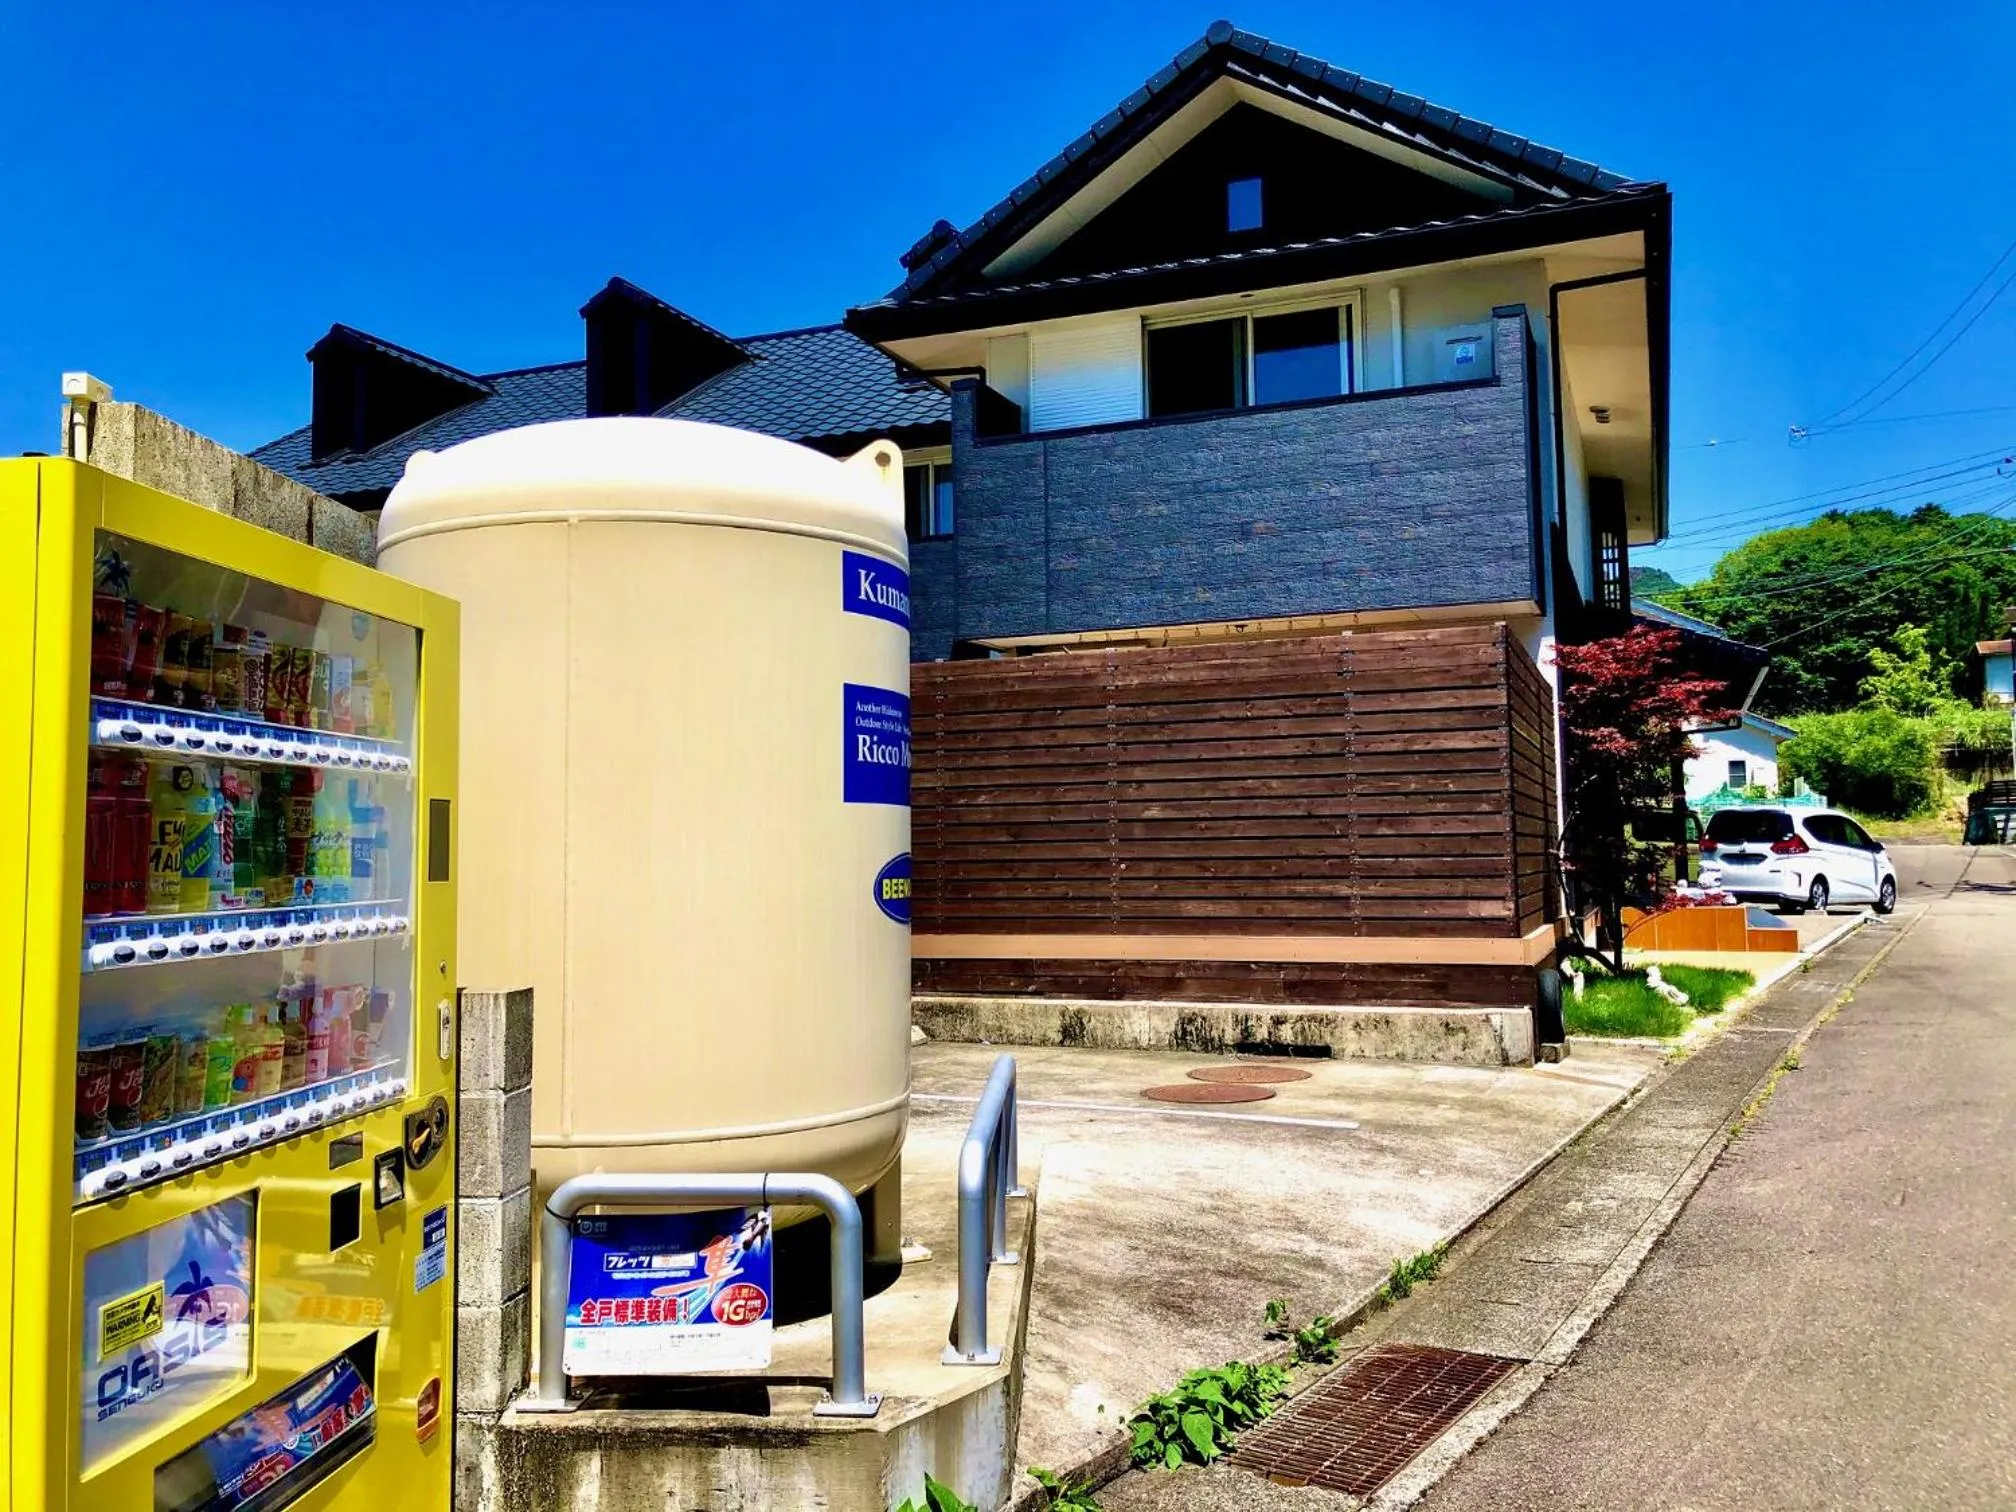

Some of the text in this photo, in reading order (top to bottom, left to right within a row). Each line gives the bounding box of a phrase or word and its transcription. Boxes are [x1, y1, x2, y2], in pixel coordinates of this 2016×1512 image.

[855, 701, 880, 714] Another
[857, 734, 899, 766] Ricco
[607, 1255, 651, 1269] フレッツ
